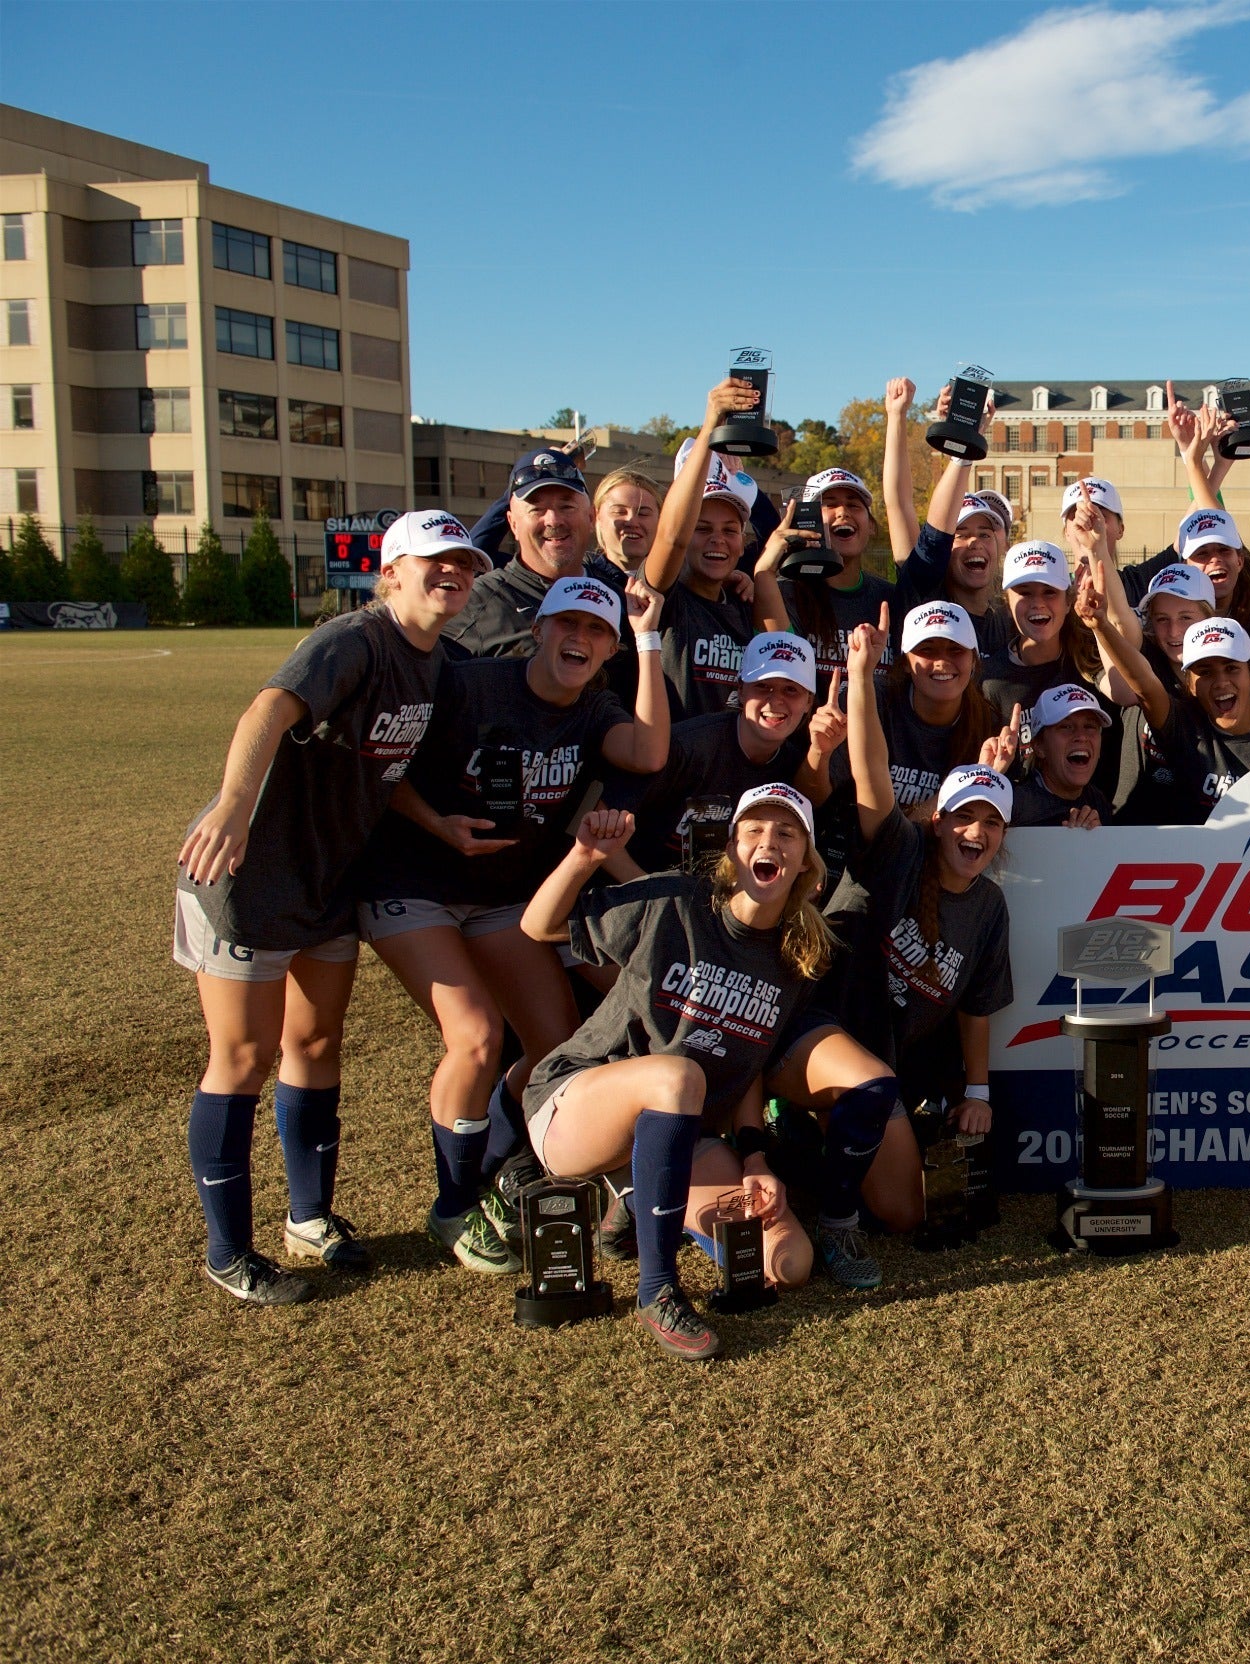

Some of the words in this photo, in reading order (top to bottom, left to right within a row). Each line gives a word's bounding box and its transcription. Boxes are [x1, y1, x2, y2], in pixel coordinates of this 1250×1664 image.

[326, 518, 375, 531] SHAW
[337, 544, 348, 559] 0
[361, 557, 371, 572] 2
[369, 712, 429, 748] Champ
[550, 745, 580, 764] EAST
[890, 764, 917, 785] 2016
[383, 900, 408, 917] G
[1087, 929, 1147, 946] BIG
[229, 943, 254, 962] G
[1077, 944, 1160, 961] EAST
[691, 960, 726, 985] 2016
[752, 979, 782, 1005] EAST
[910, 976, 942, 999] SOCCER
[661, 961, 781, 1029] Champions
[669, 998, 723, 1025] WOMEN'S
[721, 1020, 762, 1040] SOCCER
[1017, 1130, 1085, 1164] 20
[727, 1200, 757, 1211] EAST
[731, 1193, 752, 1202] BIG
[1089, 1218, 1142, 1226] GEORGETOWN
